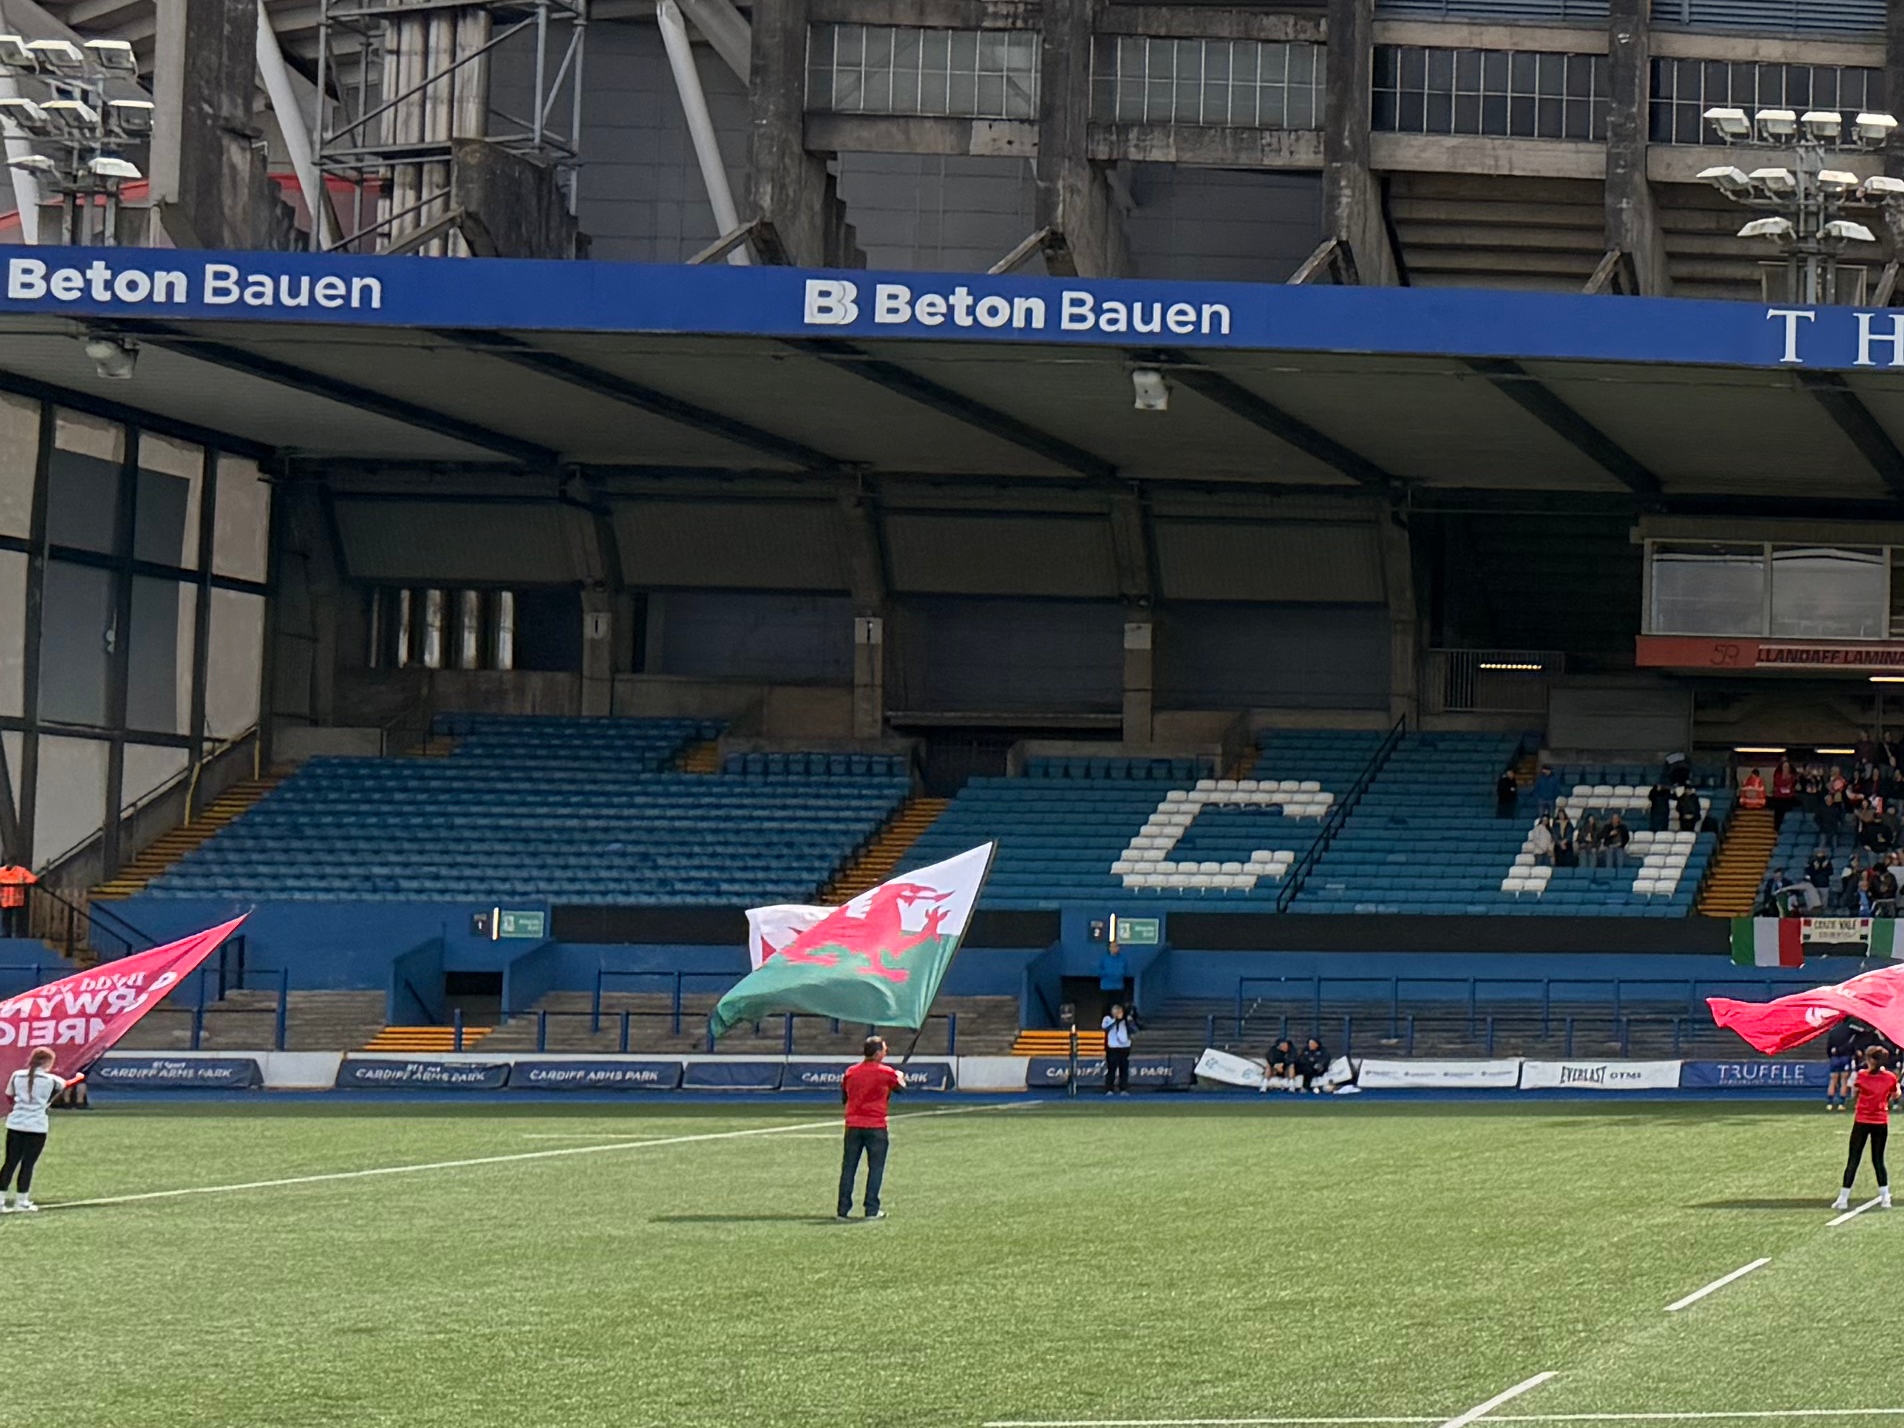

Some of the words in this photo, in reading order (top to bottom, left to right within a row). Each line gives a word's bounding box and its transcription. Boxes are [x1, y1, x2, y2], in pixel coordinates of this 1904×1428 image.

[8, 258, 188, 303] Beton
[203, 263, 381, 308] Bauen
[874, 283, 1046, 329] Beton
[1061, 290, 1231, 334] Bauen
[1757, 647, 1841, 664] LLANDAFF
[157, 1068, 195, 1079] ARMS
[529, 1070, 585, 1081] CARDIFF
[587, 1071, 623, 1082] ARMS
[625, 1071, 659, 1082] PARK
[1560, 1065, 1606, 1084] EVERLAST
[1610, 1072, 1641, 1080] GYMS
[1717, 1064, 1805, 1079] TRUFFLE
